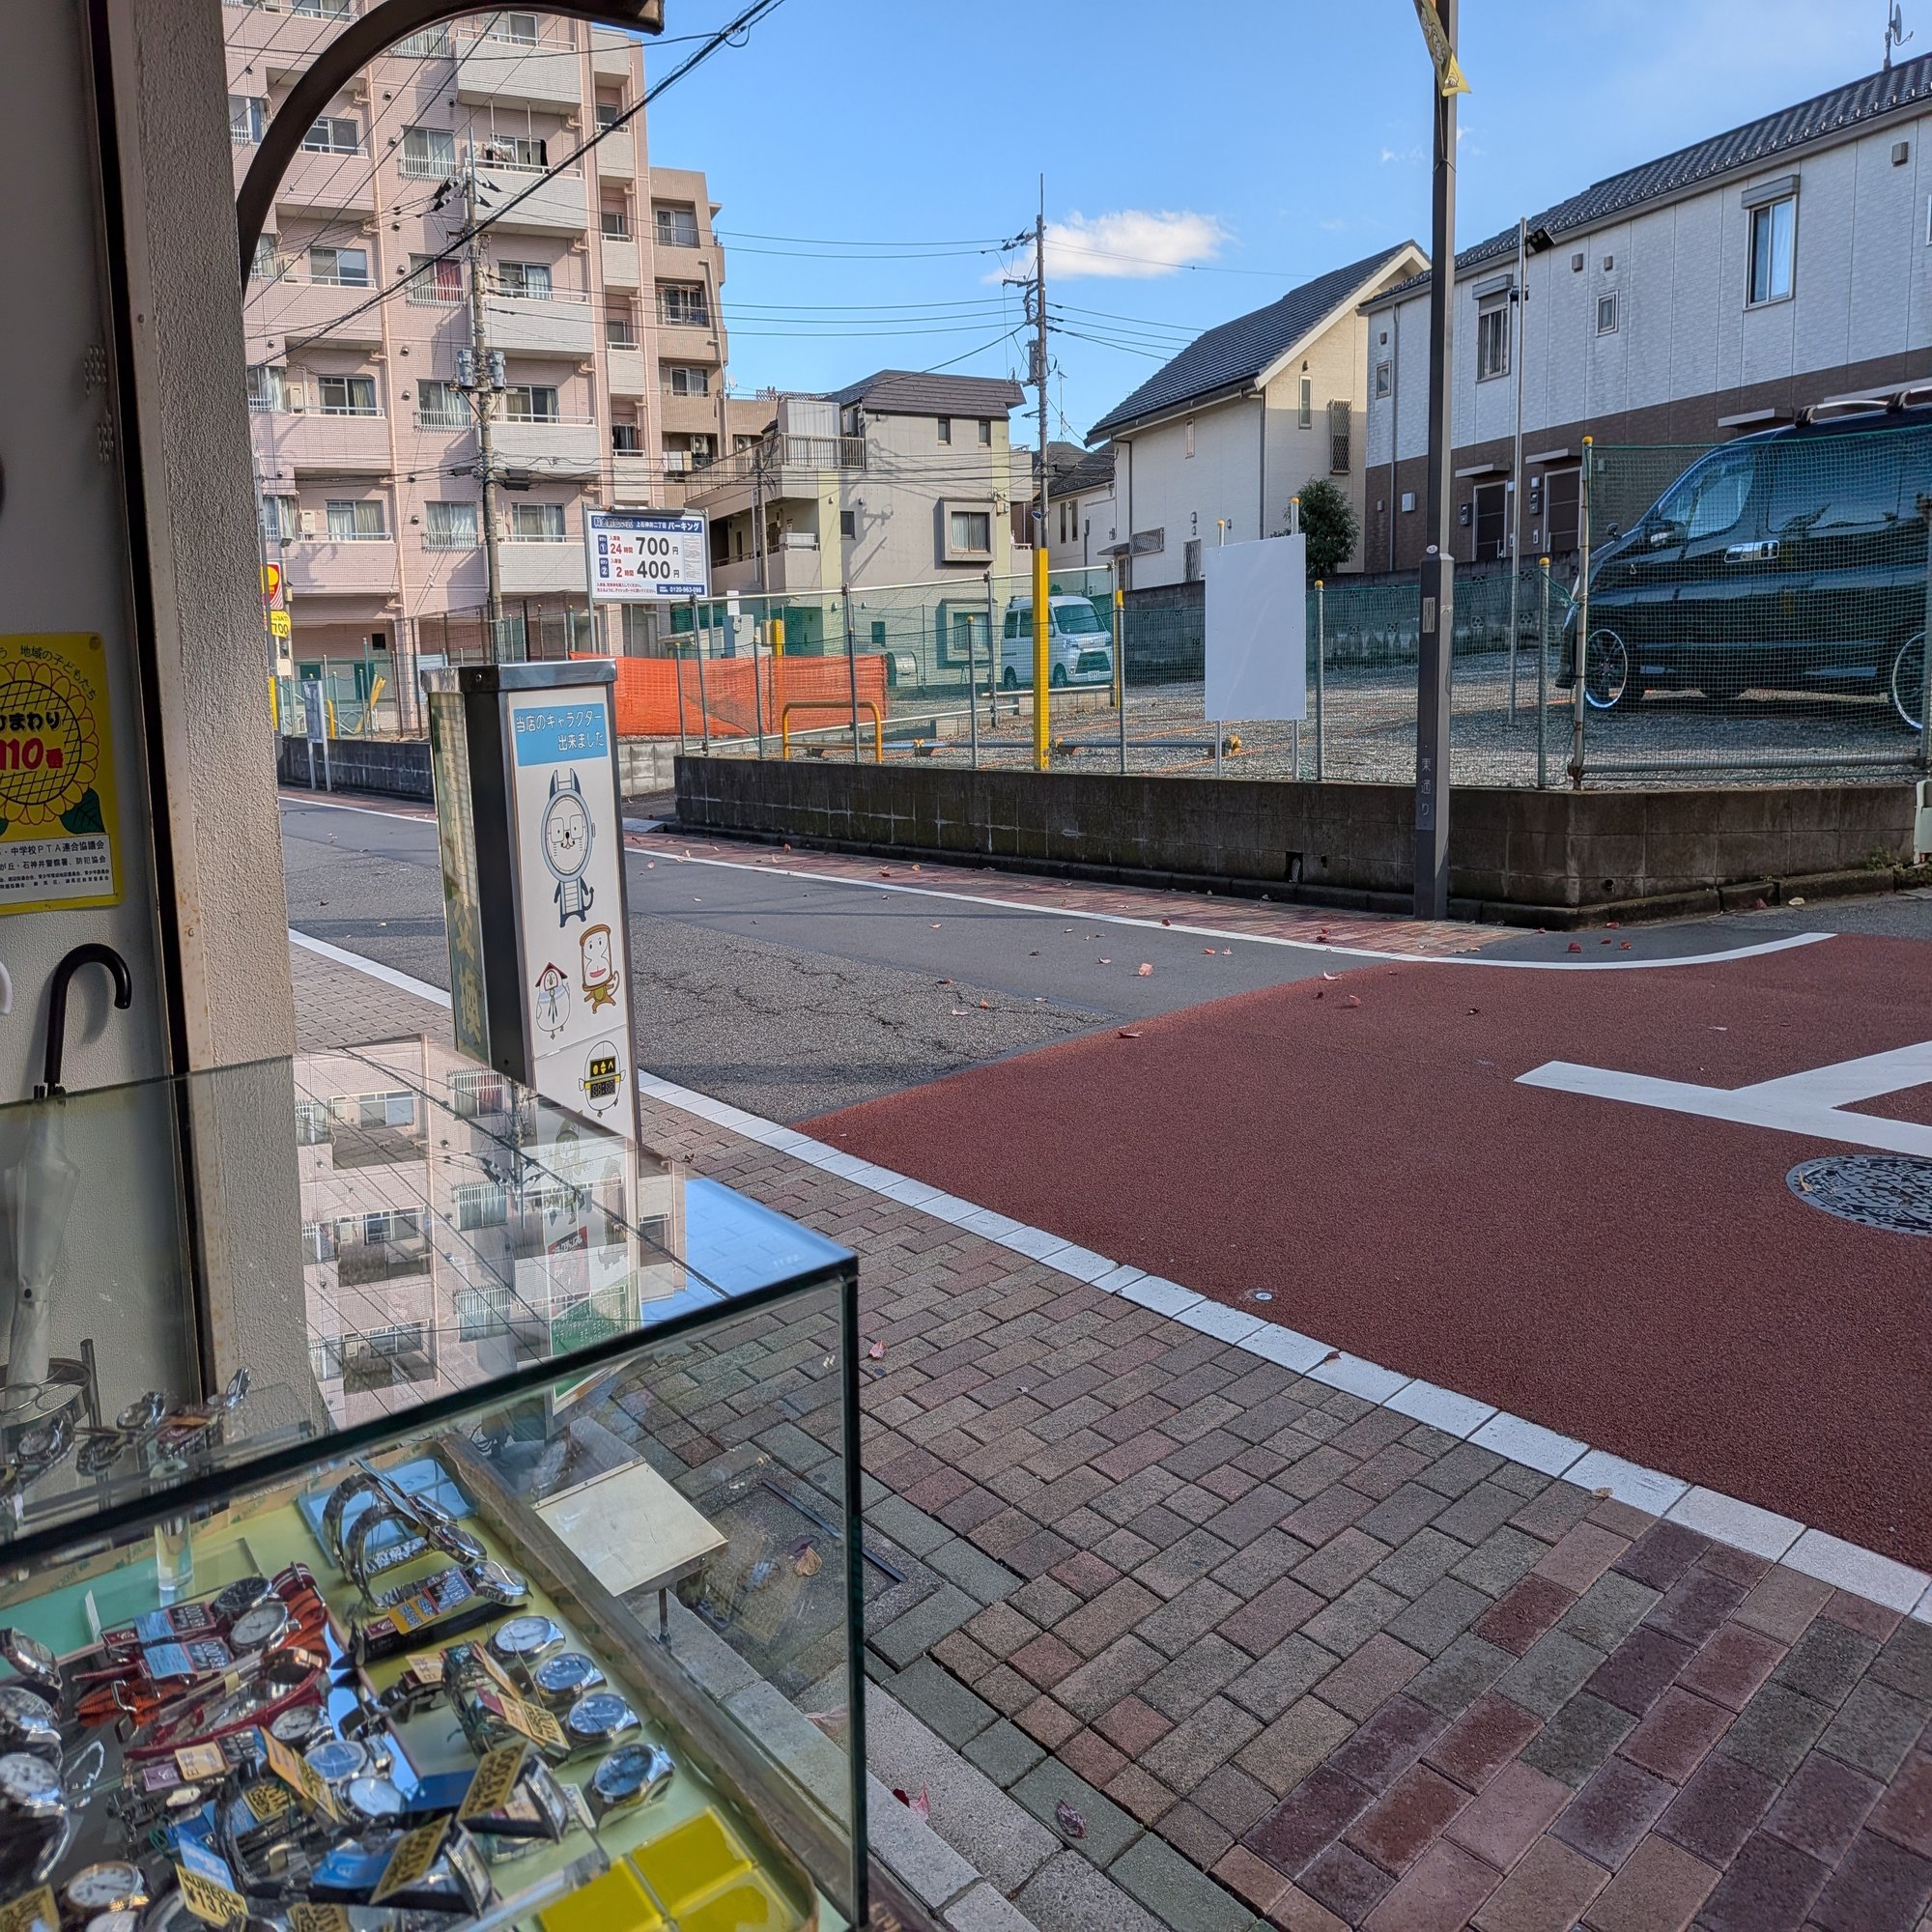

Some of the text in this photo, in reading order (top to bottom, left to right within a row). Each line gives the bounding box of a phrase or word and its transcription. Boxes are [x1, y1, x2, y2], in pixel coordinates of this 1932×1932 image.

[668, 522, 700, 531] パーキング
[516, 710, 603, 733] 当店のキャラクター
[557, 731, 605, 752] 出来ました
[1420, 757, 1432, 816] 東通り
[0, 839, 105, 857] ・中学校PTA連合協議会
